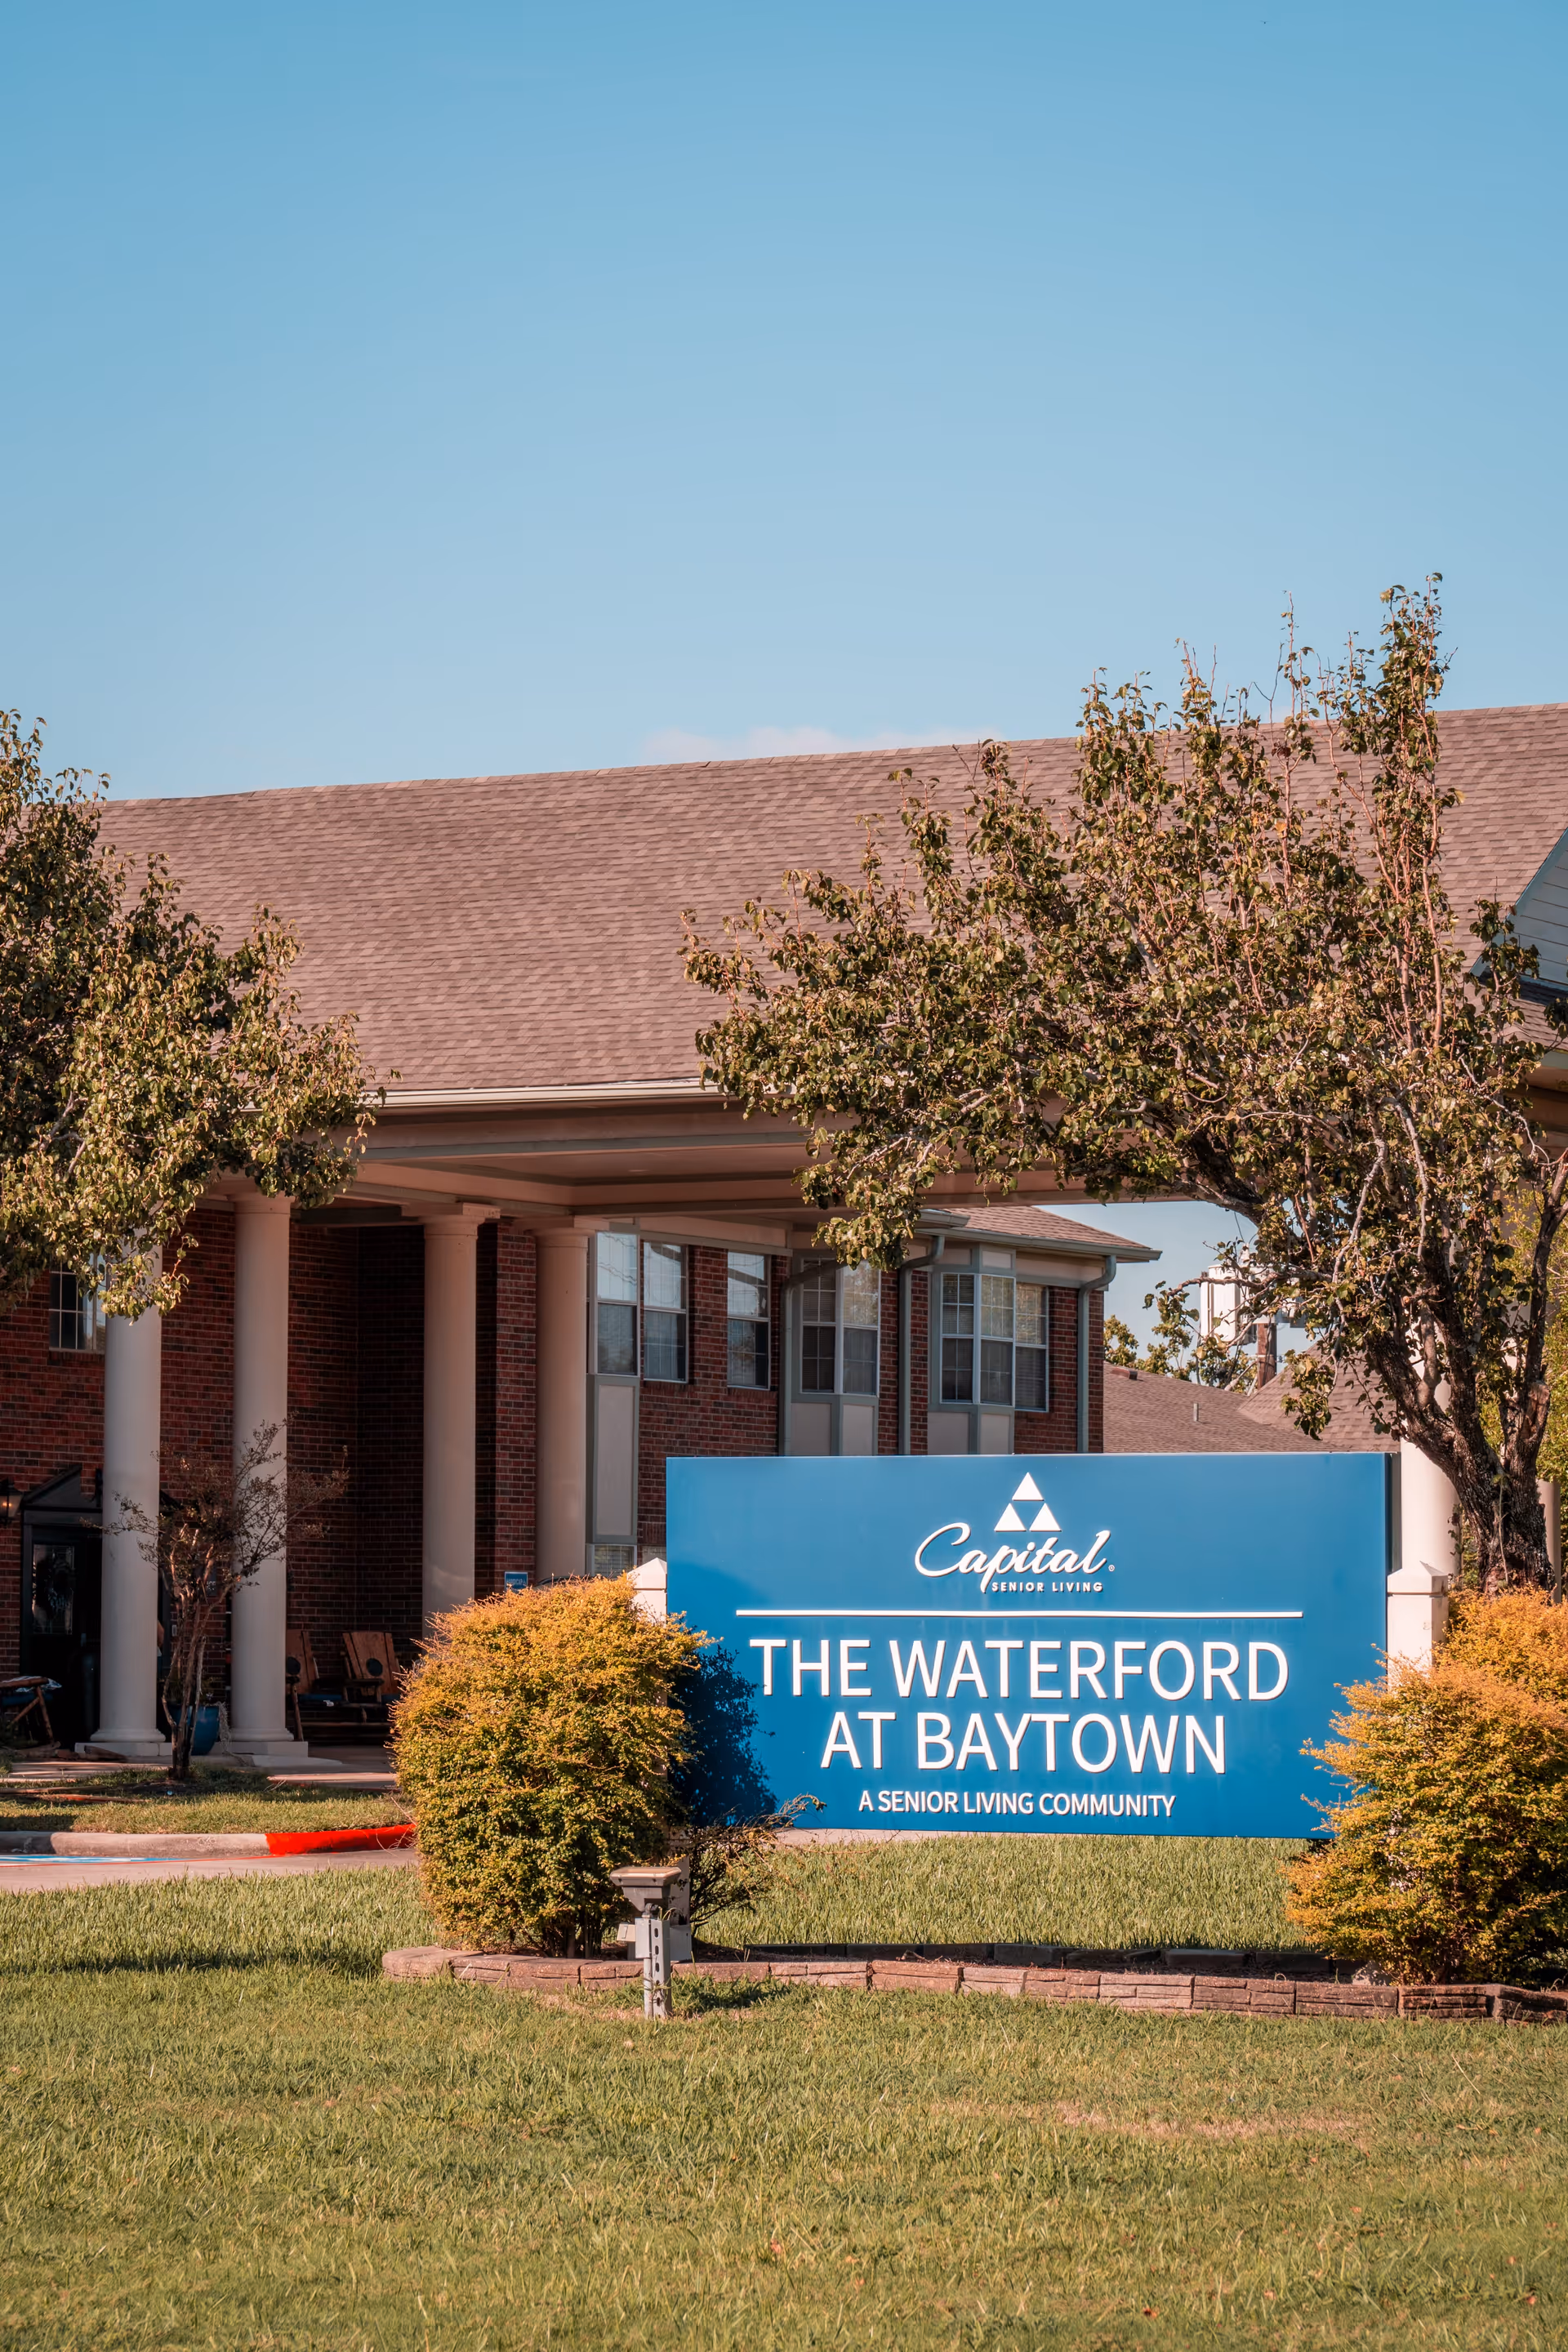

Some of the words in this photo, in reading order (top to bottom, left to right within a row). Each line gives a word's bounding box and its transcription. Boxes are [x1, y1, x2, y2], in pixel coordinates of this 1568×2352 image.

[914, 1521, 1112, 1594] Capital
[991, 1581, 1045, 1592] SENIOR
[1052, 1581, 1102, 1592] LIVING
[749, 1638, 872, 1697] THE
[889, 1639, 1289, 1701] WATERFORD
[820, 1711, 896, 1769] AT
[916, 1712, 1225, 1774] BAYTOWN
[858, 1789, 875, 1811] A
[878, 1789, 960, 1813] SENIOR
[963, 1791, 1034, 1815] LIVING
[1039, 1793, 1176, 1817] COMMUNITY
